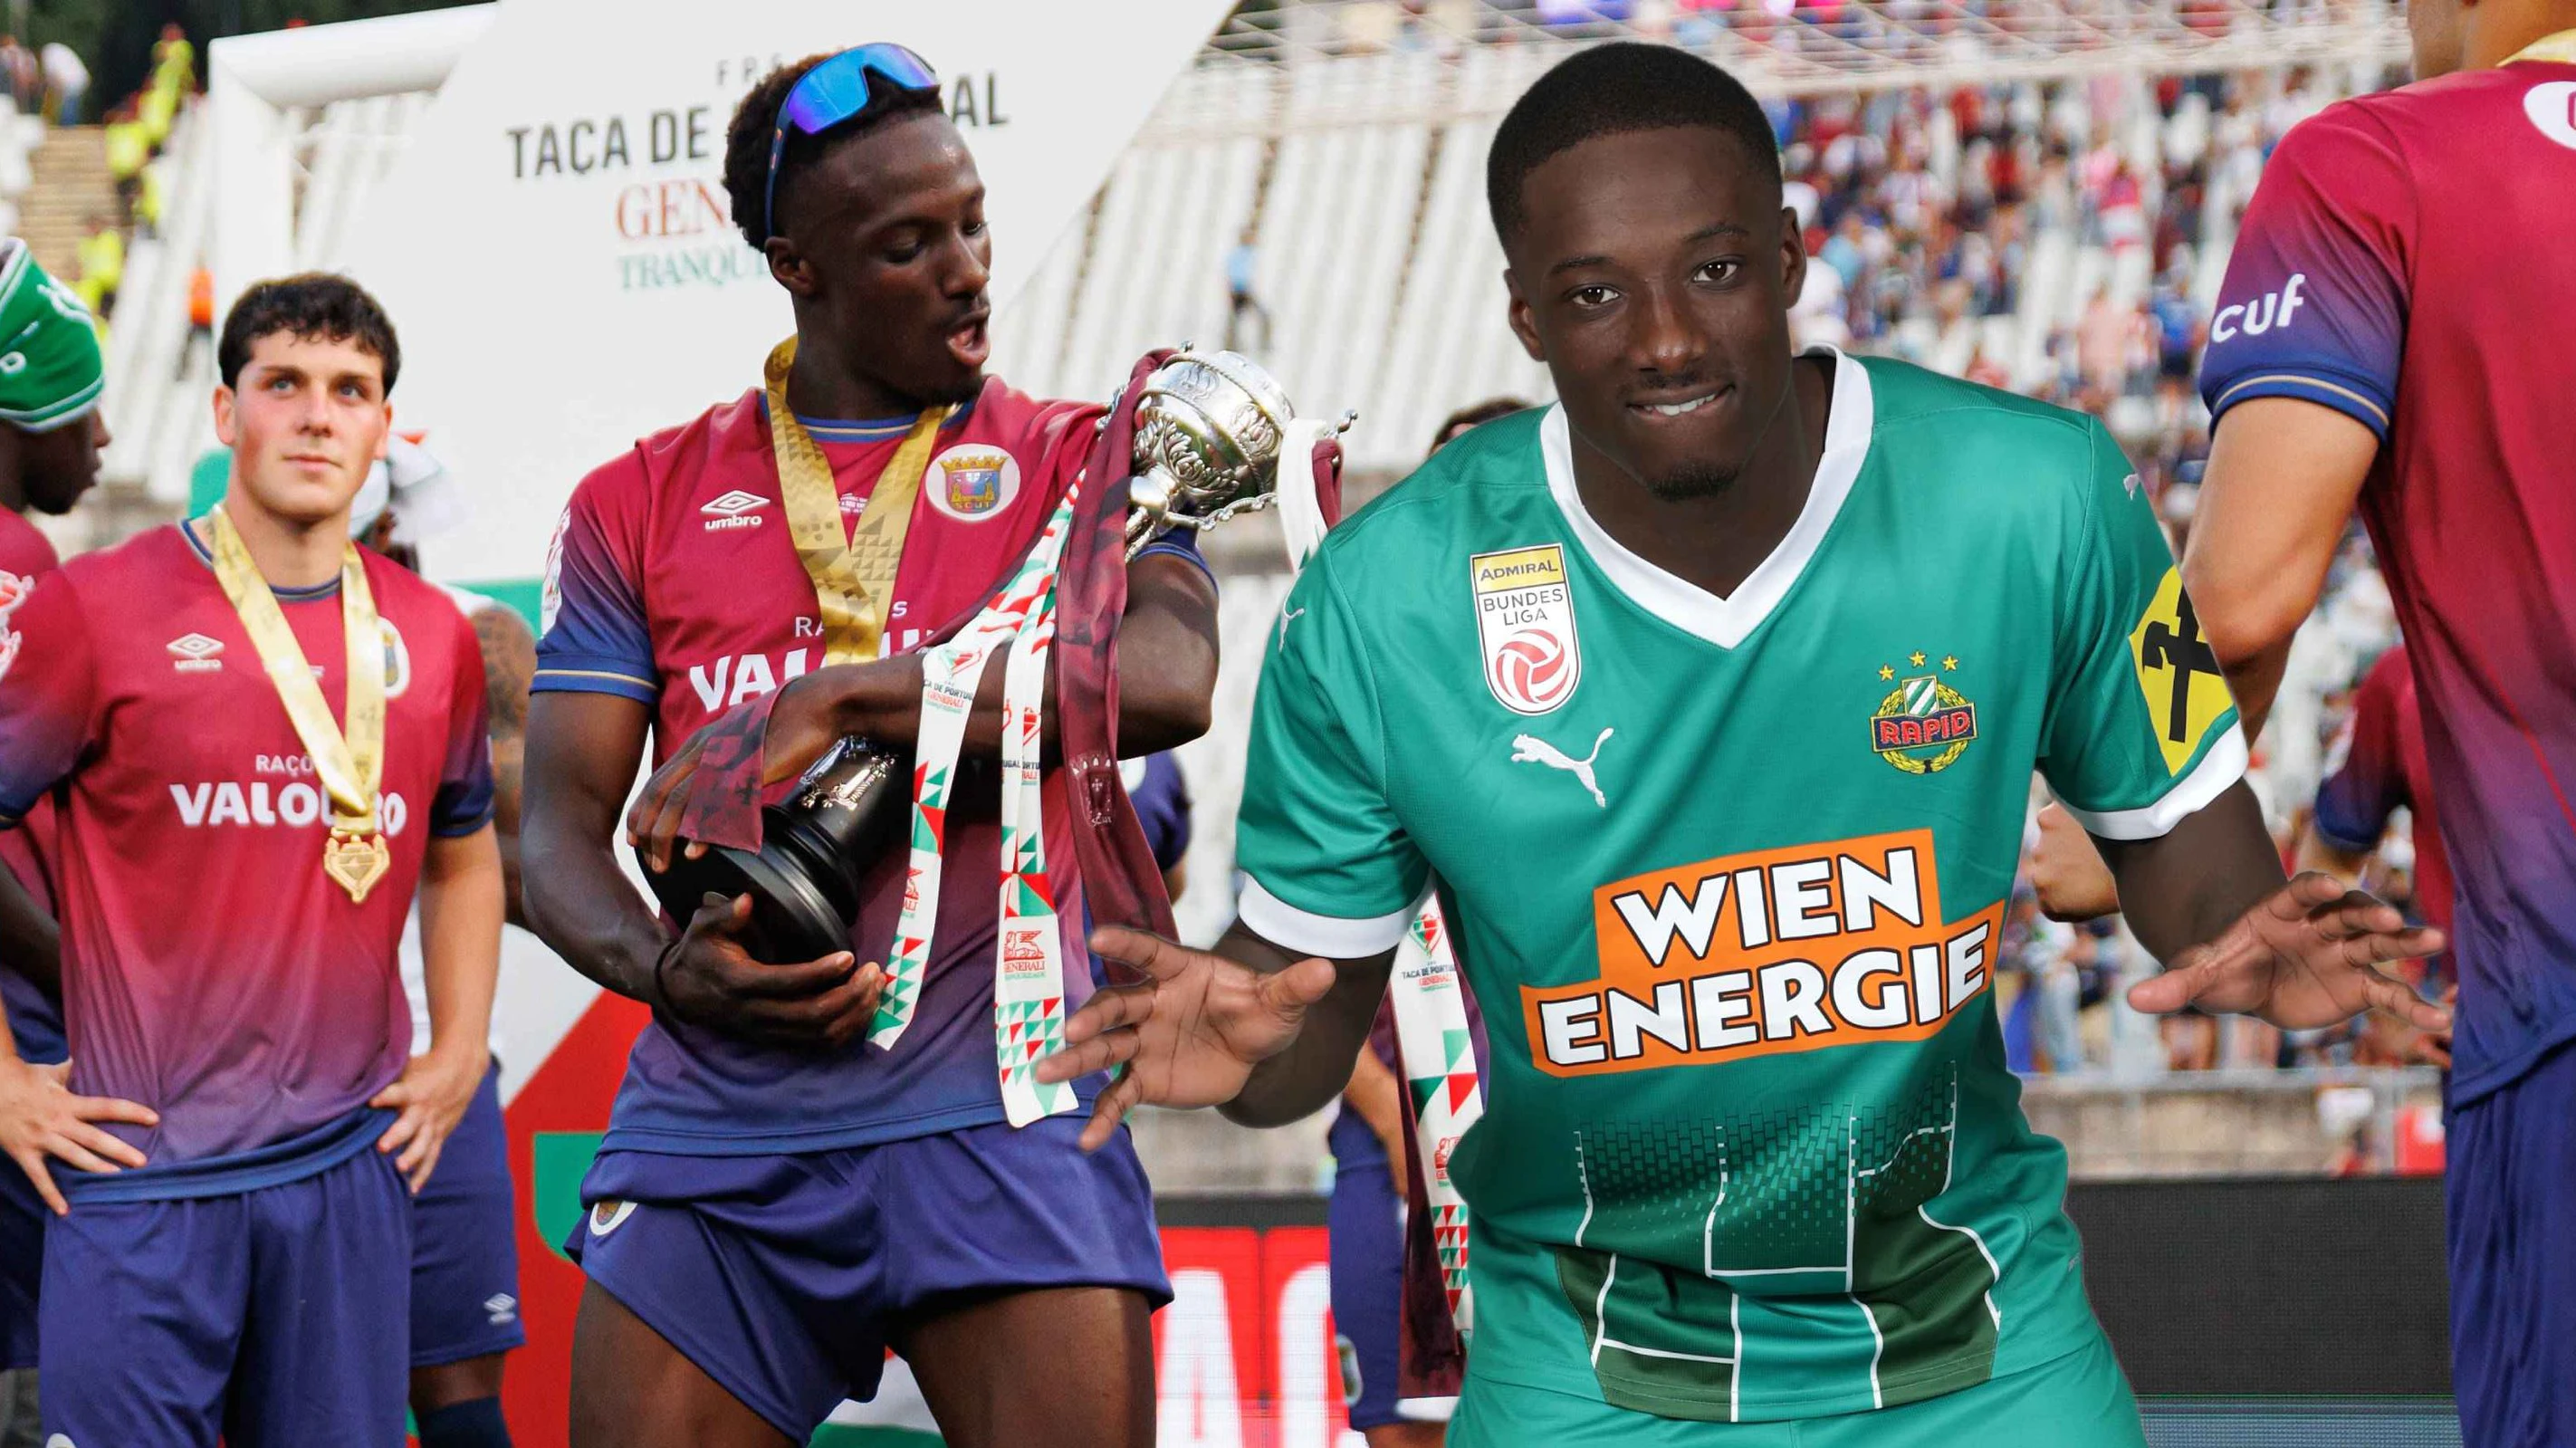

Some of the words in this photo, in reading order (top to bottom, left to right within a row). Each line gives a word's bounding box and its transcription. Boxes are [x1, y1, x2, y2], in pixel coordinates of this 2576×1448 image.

[650, 107, 711, 163] DE
[2212, 273, 2305, 342] cuf
[705, 514, 762, 530] umbro
[1480, 559, 1558, 581] ADMIRAL
[1483, 589, 1564, 613] BUNDES
[1504, 609, 1548, 626] LIGA
[1879, 711, 1970, 744] RAPID
[169, 782, 407, 837] VALOO
[1611, 846, 1923, 968] WIEN
[1538, 919, 1990, 1066] ENERGIE
